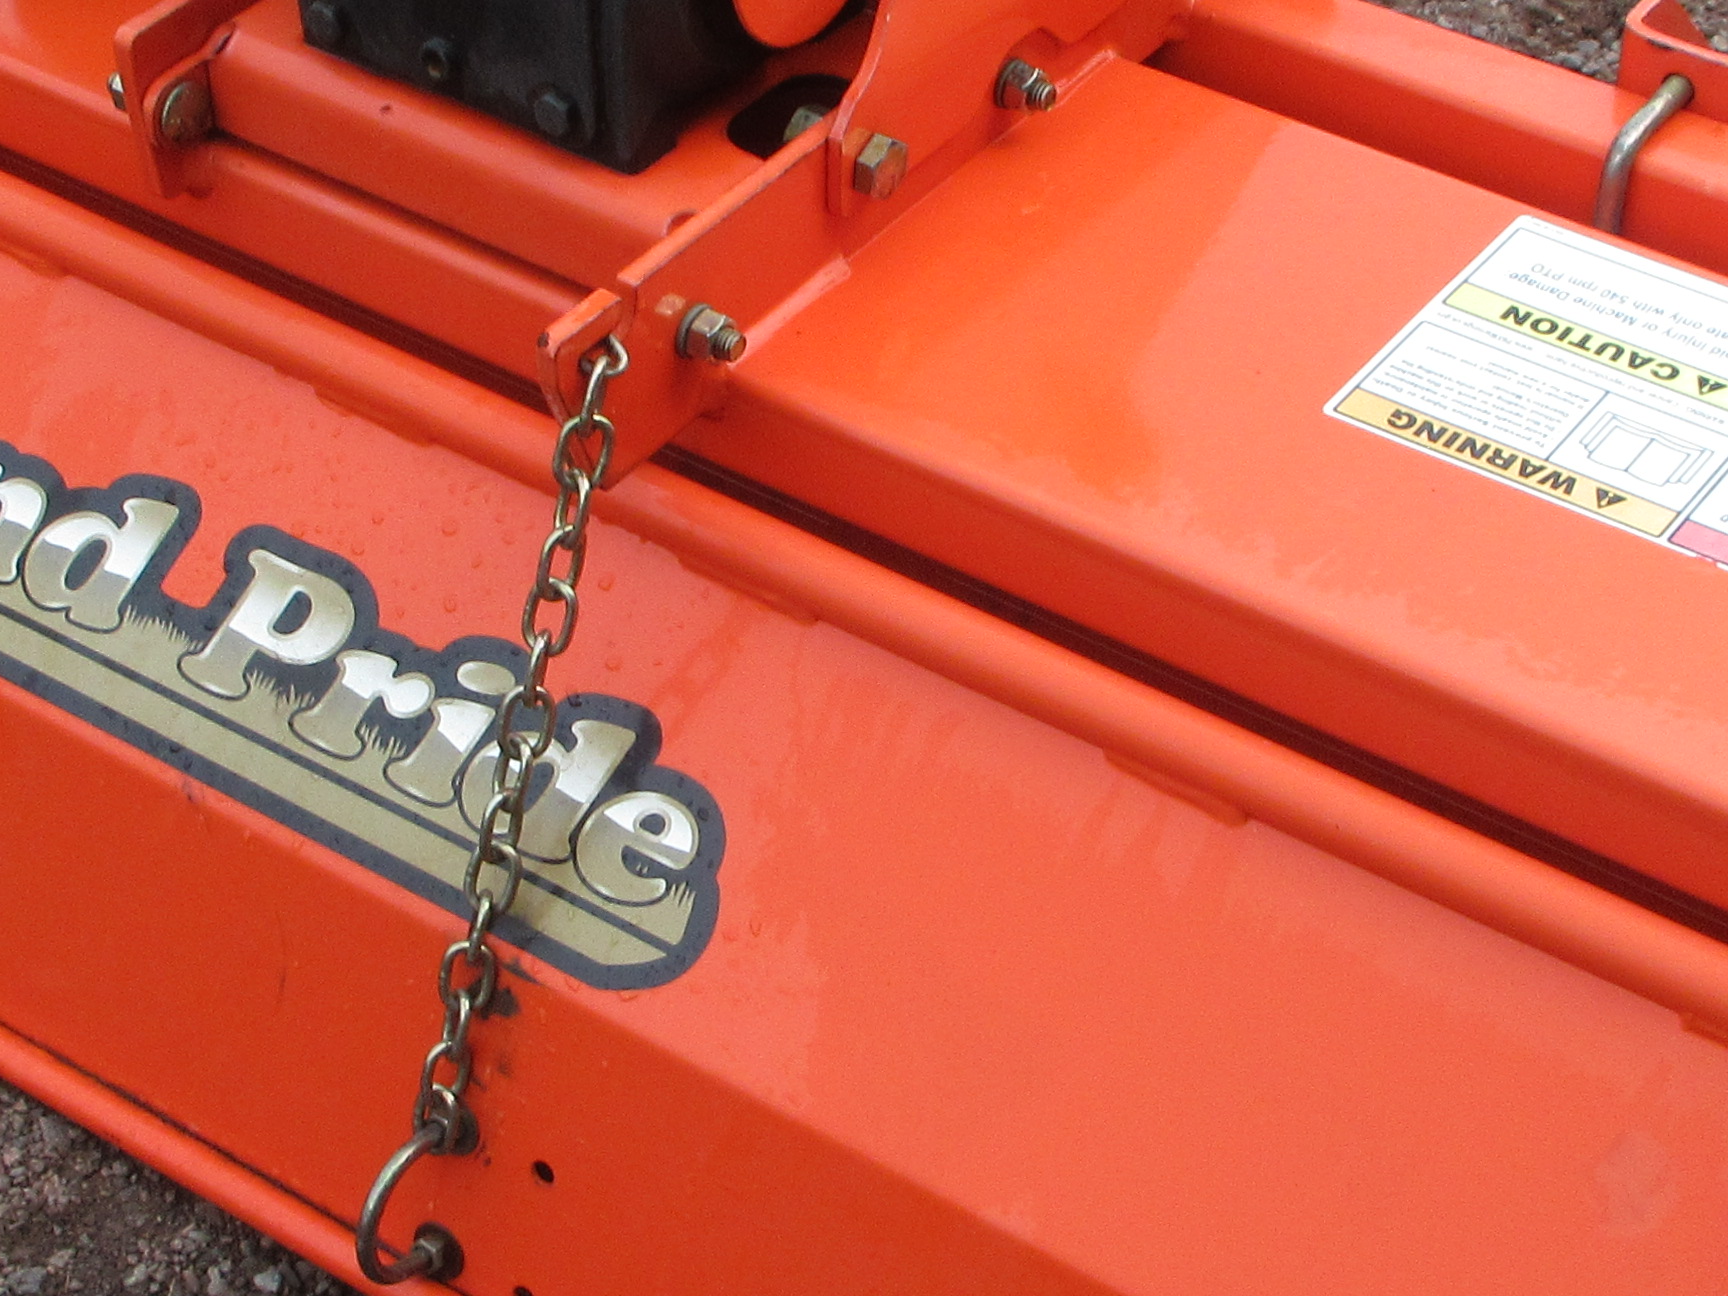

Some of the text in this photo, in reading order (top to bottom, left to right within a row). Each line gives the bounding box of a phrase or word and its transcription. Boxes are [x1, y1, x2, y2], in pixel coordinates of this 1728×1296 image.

[1496, 304, 1684, 383] CAUTION
[1569, 295, 1639, 326] Machine
[1380, 407, 1583, 495] WARNING
[177, 548, 700, 906] Pride
